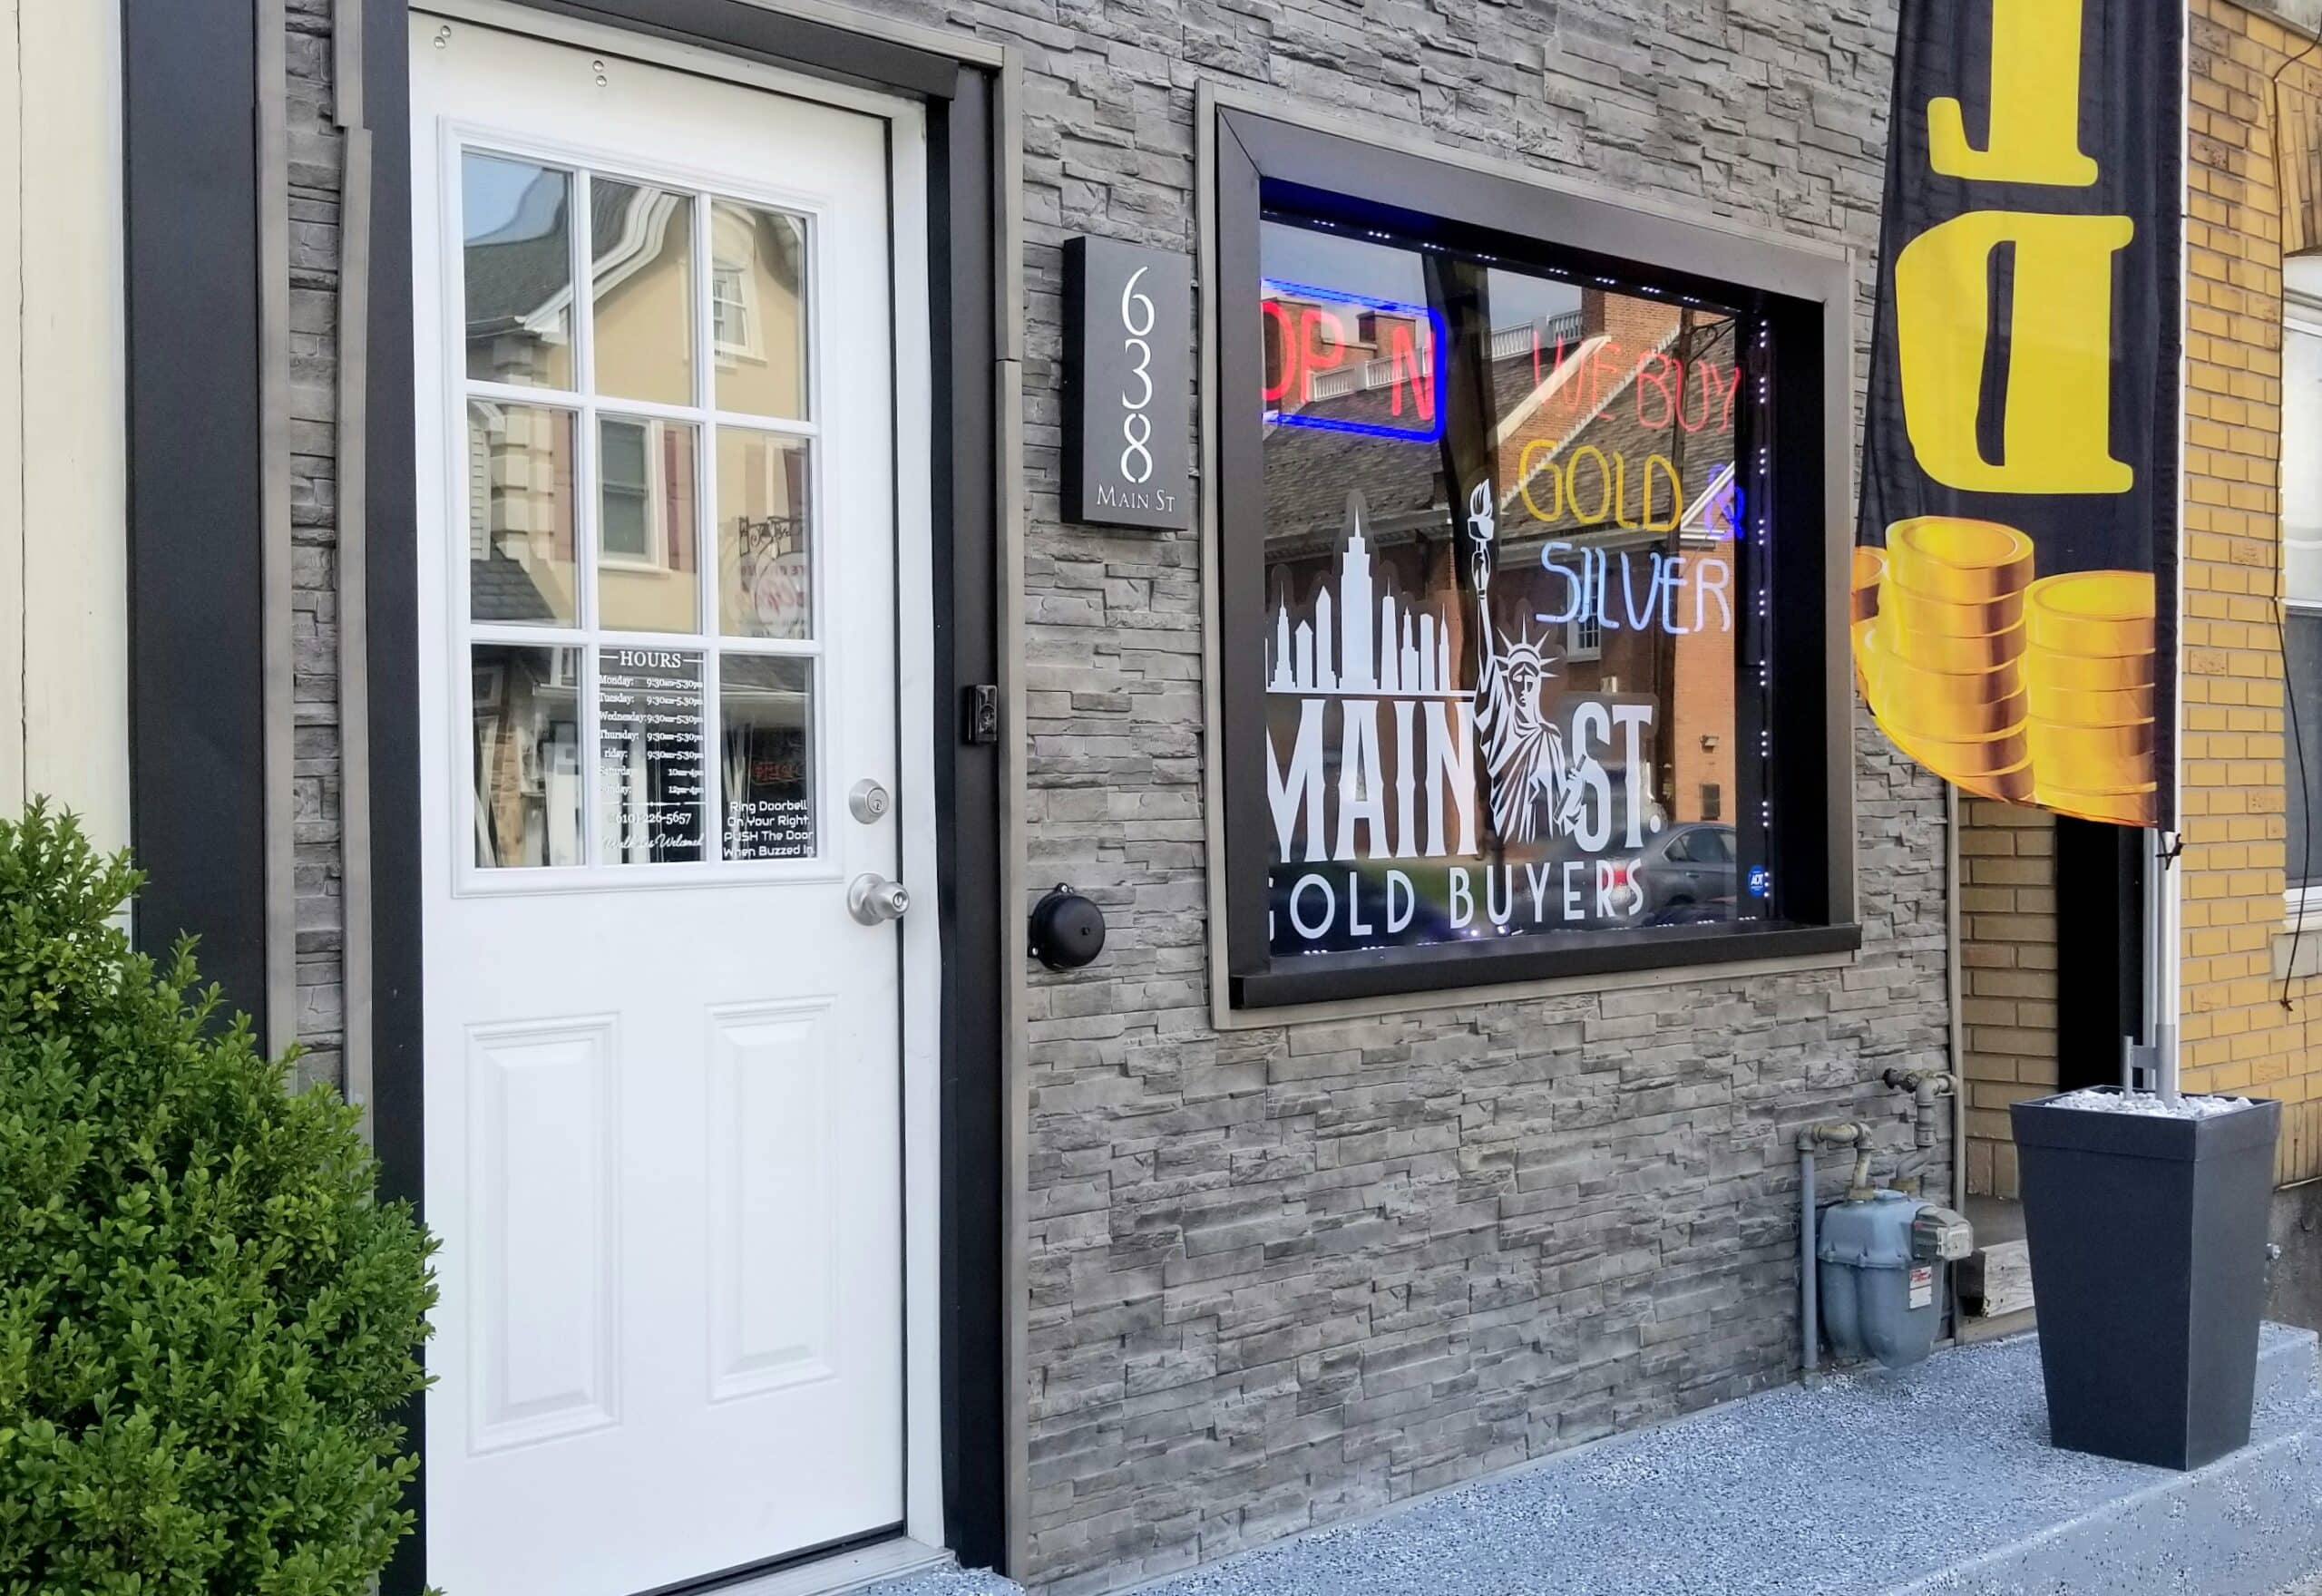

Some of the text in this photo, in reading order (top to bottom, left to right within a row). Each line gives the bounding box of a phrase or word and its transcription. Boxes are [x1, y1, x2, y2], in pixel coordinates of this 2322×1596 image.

[1121, 266, 1155, 484] 638
[1262, 301, 1436, 421] OPN
[1636, 349, 1742, 433] BUY
[1518, 439, 1683, 532] GOLD
[1536, 541, 1732, 635] SILVER
[620, 650, 681, 668] HOURS
[727, 816, 744, 827] On
[746, 817, 775, 827] Your
[730, 800, 807, 814] Ring Doorbell
[1265, 698, 1479, 863] MAIN
[723, 846, 756, 857] When
[758, 844, 800, 856] Buzzed
[724, 830, 814, 842] PUSH The Door
[1269, 857, 1644, 939] OLD BUYERS
